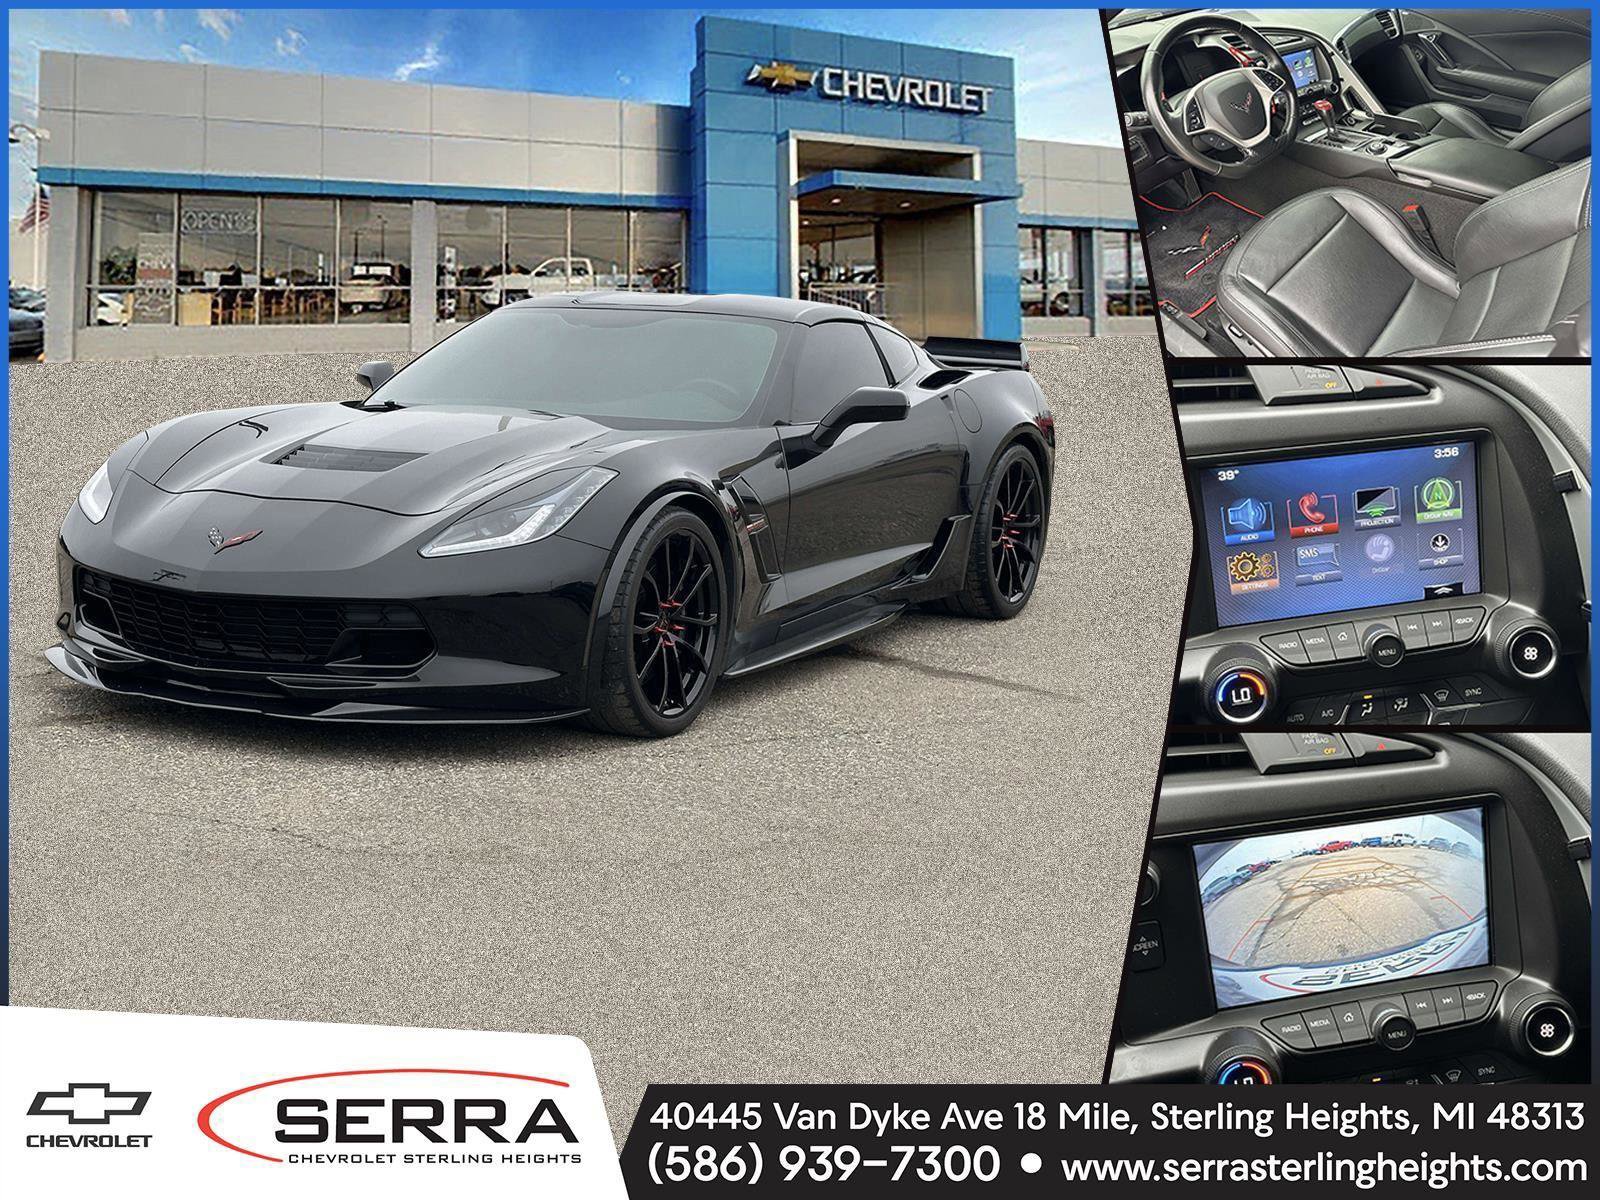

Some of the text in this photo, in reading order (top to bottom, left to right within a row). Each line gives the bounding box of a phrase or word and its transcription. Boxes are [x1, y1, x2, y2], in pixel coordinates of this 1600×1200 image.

[822, 66, 993, 113] CHEVROLET
[1434, 447, 1459, 458] 3:56
[1240, 533, 1259, 541] AUDIO
[1299, 548, 1319, 559] SMS
[1278, 641, 1298, 650] RADIO
[1305, 636, 1326, 645] MEDIA
[1378, 648, 1397, 657] MENU
[1231, 687, 1252, 703] LO
[1464, 687, 1482, 697] SYNC
[1286, 713, 1305, 723] AUTO
[1321, 708, 1335, 718] A/C
[1310, 1018, 1331, 1028] MEDIA
[1281, 1024, 1302, 1034] RADIO
[1387, 1030, 1407, 1040] MENU
[1477, 1065, 1496, 1077] SYNC
